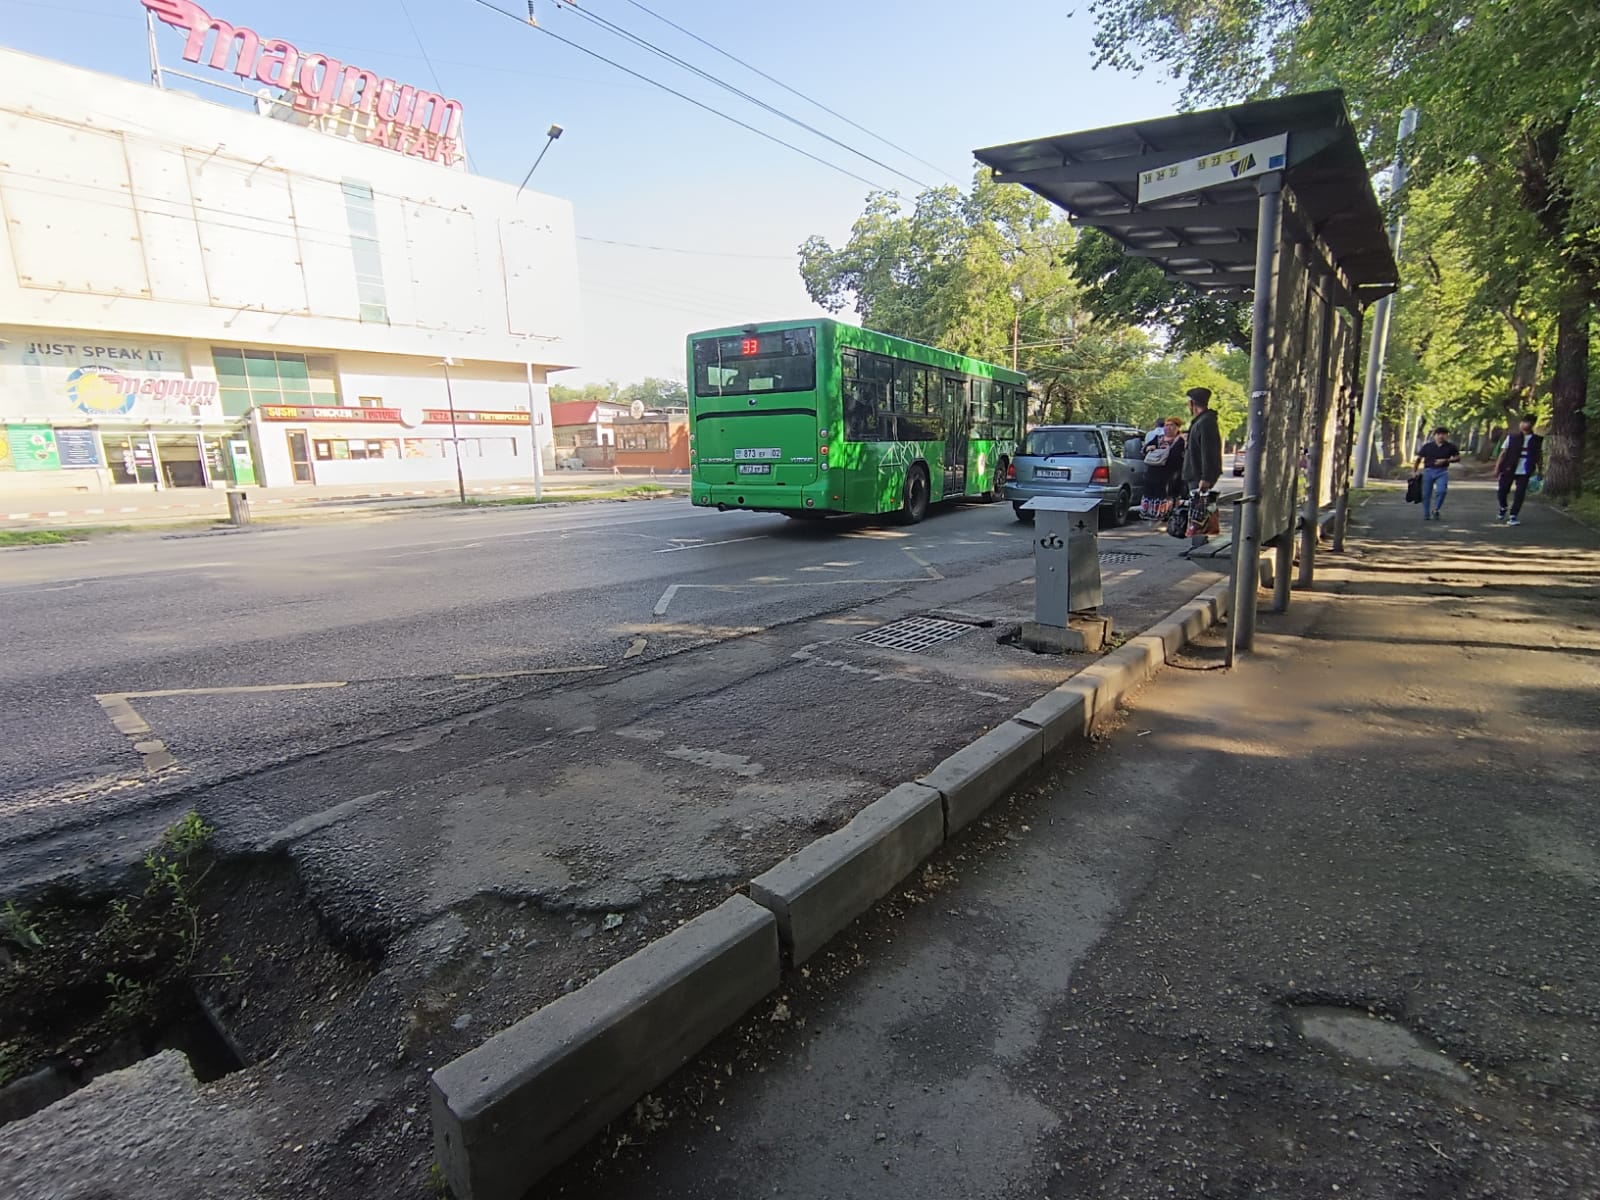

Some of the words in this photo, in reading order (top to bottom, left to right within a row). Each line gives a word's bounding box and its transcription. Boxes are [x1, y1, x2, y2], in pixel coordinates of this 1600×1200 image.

[142, 0, 463, 141] magnum
[367, 121, 457, 167] ATAK
[28, 343, 75, 355] JUST
[82, 345, 143, 360] SPEAK
[147, 349, 164, 360] IT
[743, 340, 757, 354] 33
[98, 374, 217, 400] magnum
[179, 396, 212, 406] ATAK
[266, 406, 299, 417] SUSHI
[743, 449, 756, 458] 873
[772, 449, 781, 457] 02
